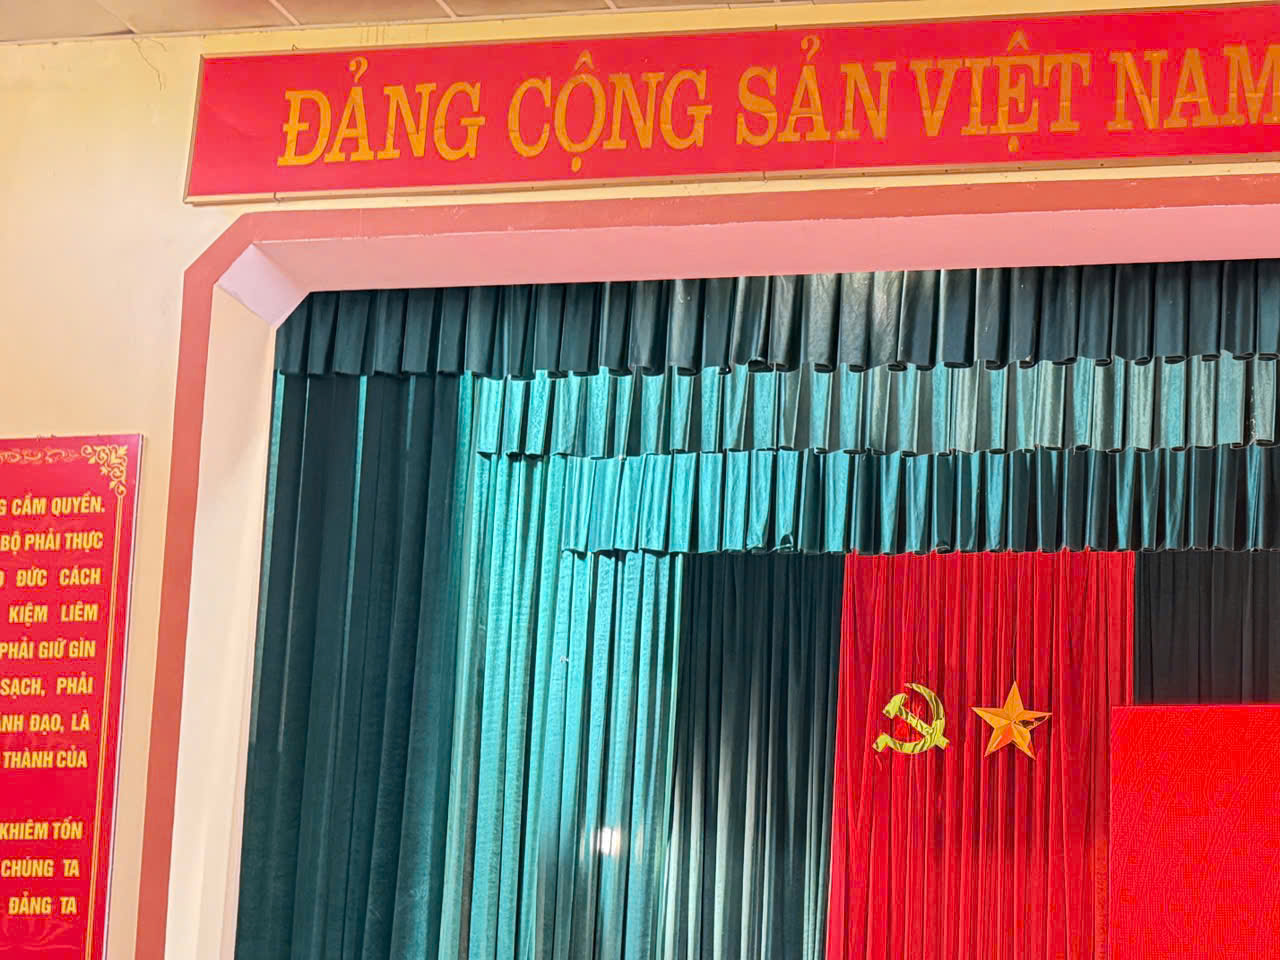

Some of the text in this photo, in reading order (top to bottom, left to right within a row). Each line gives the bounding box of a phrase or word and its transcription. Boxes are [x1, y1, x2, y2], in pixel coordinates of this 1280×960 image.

[277, 56, 486, 167] ĐẢNG
[507, 50, 713, 173] CỘNG
[735, 35, 897, 147] SẢN
[911, 31, 1090, 153] VIỆT
[24, 527, 61, 552] PHẢI
[64, 530, 104, 553] THỰC
[59, 565, 101, 586] CÁCH
[8, 600, 99, 627] KIỆM LIÊM
[56, 671, 94, 695] PHẢI
[56, 744, 88, 769] CỦA
[1, 856, 80, 878] CHÚNG TA
[9, 891, 77, 915] ĐẢNG TA
